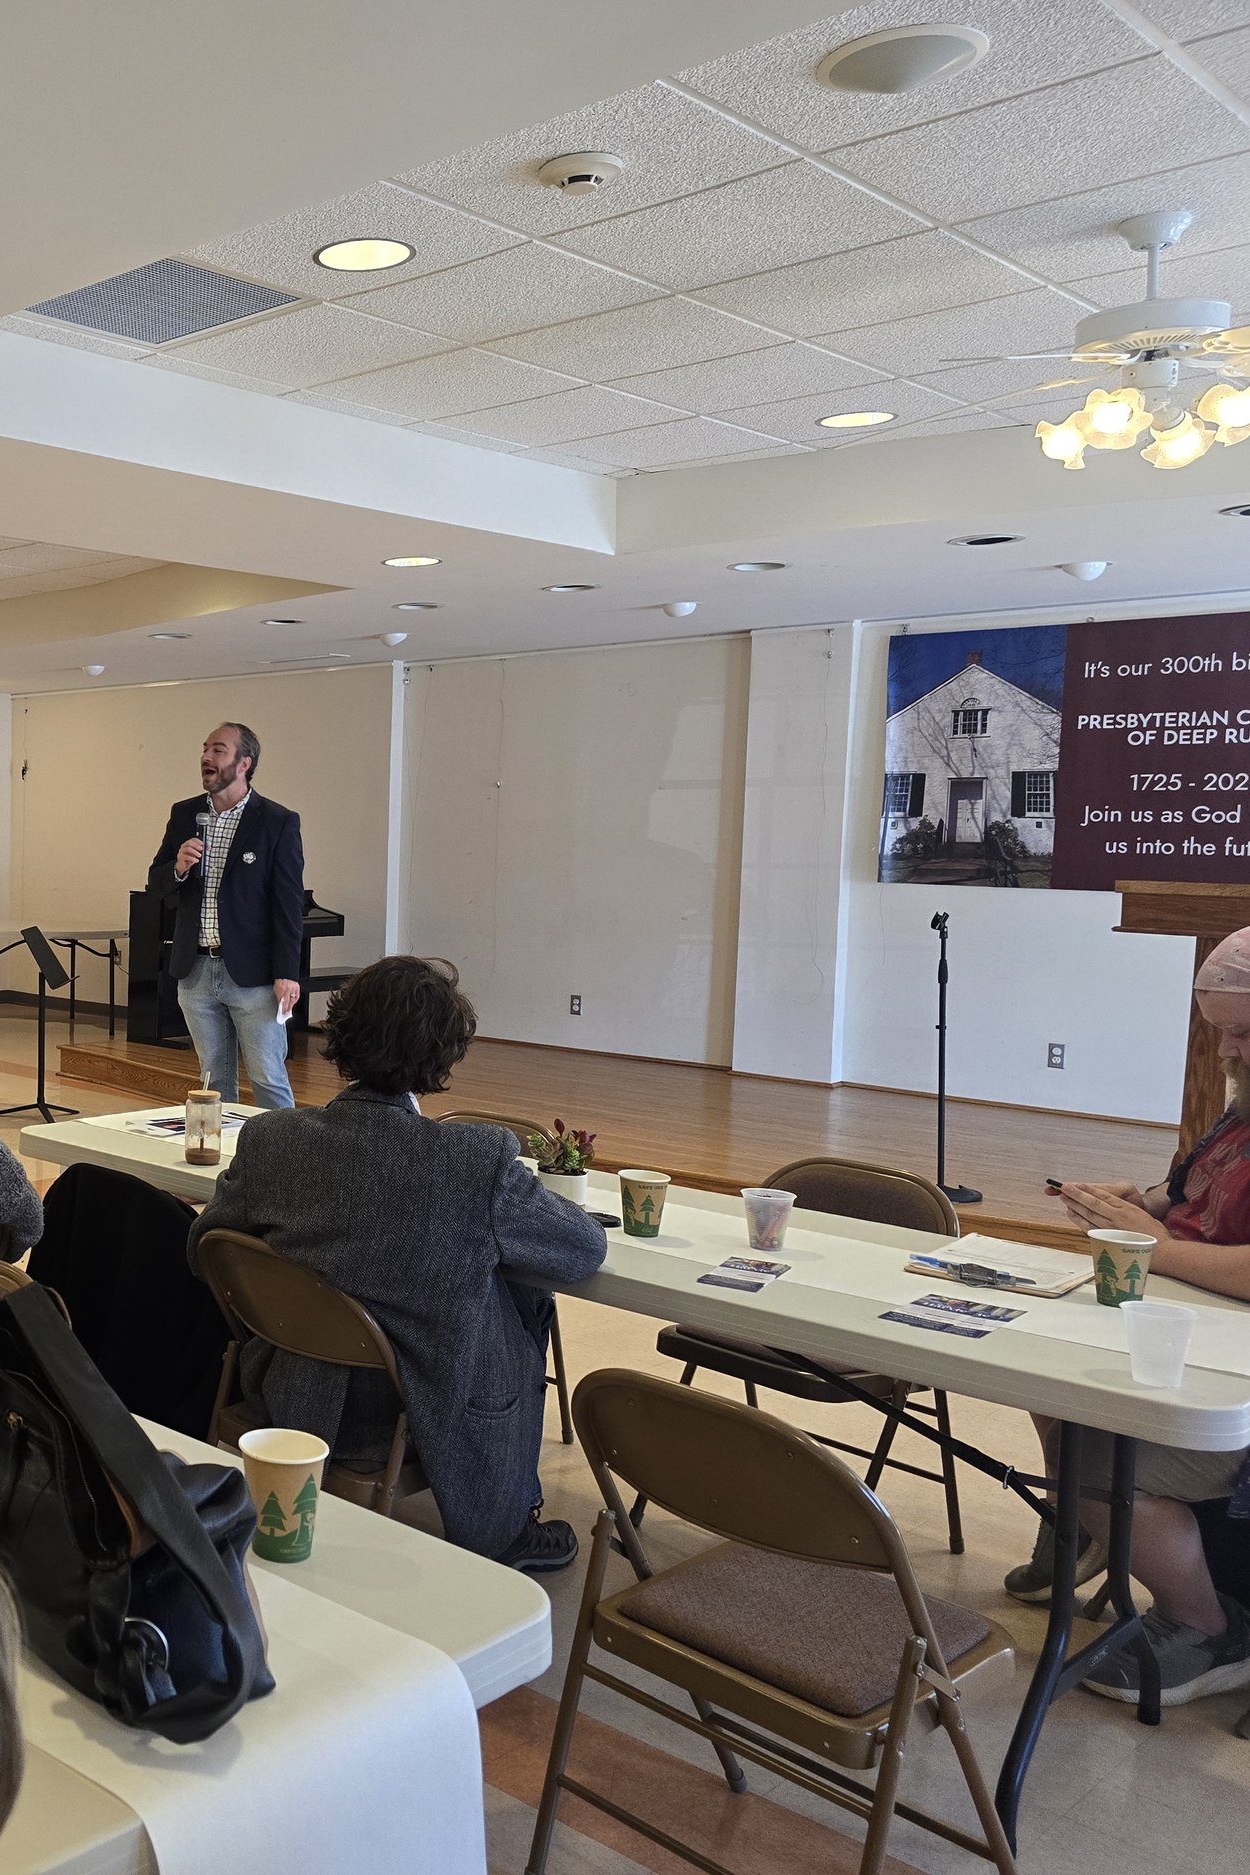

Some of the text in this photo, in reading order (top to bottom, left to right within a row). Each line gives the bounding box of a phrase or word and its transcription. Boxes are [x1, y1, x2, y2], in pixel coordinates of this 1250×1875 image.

[1084, 661, 1110, 678] It's
[1117, 662, 1152, 677] our
[1160, 653, 1223, 675] 300th
[1077, 710, 1229, 730] PRESBYTERIAN
[1127, 730, 1157, 746] OF
[1163, 728, 1218, 745] DEEP
[1129, 773, 1183, 791] 1725
[1202, 773, 1249, 791] 202
[1080, 804, 1242, 827] Join us as God
[1105, 841, 1128, 854] us
[1136, 836, 1175, 855] into
[1182, 836, 1216, 855] the
